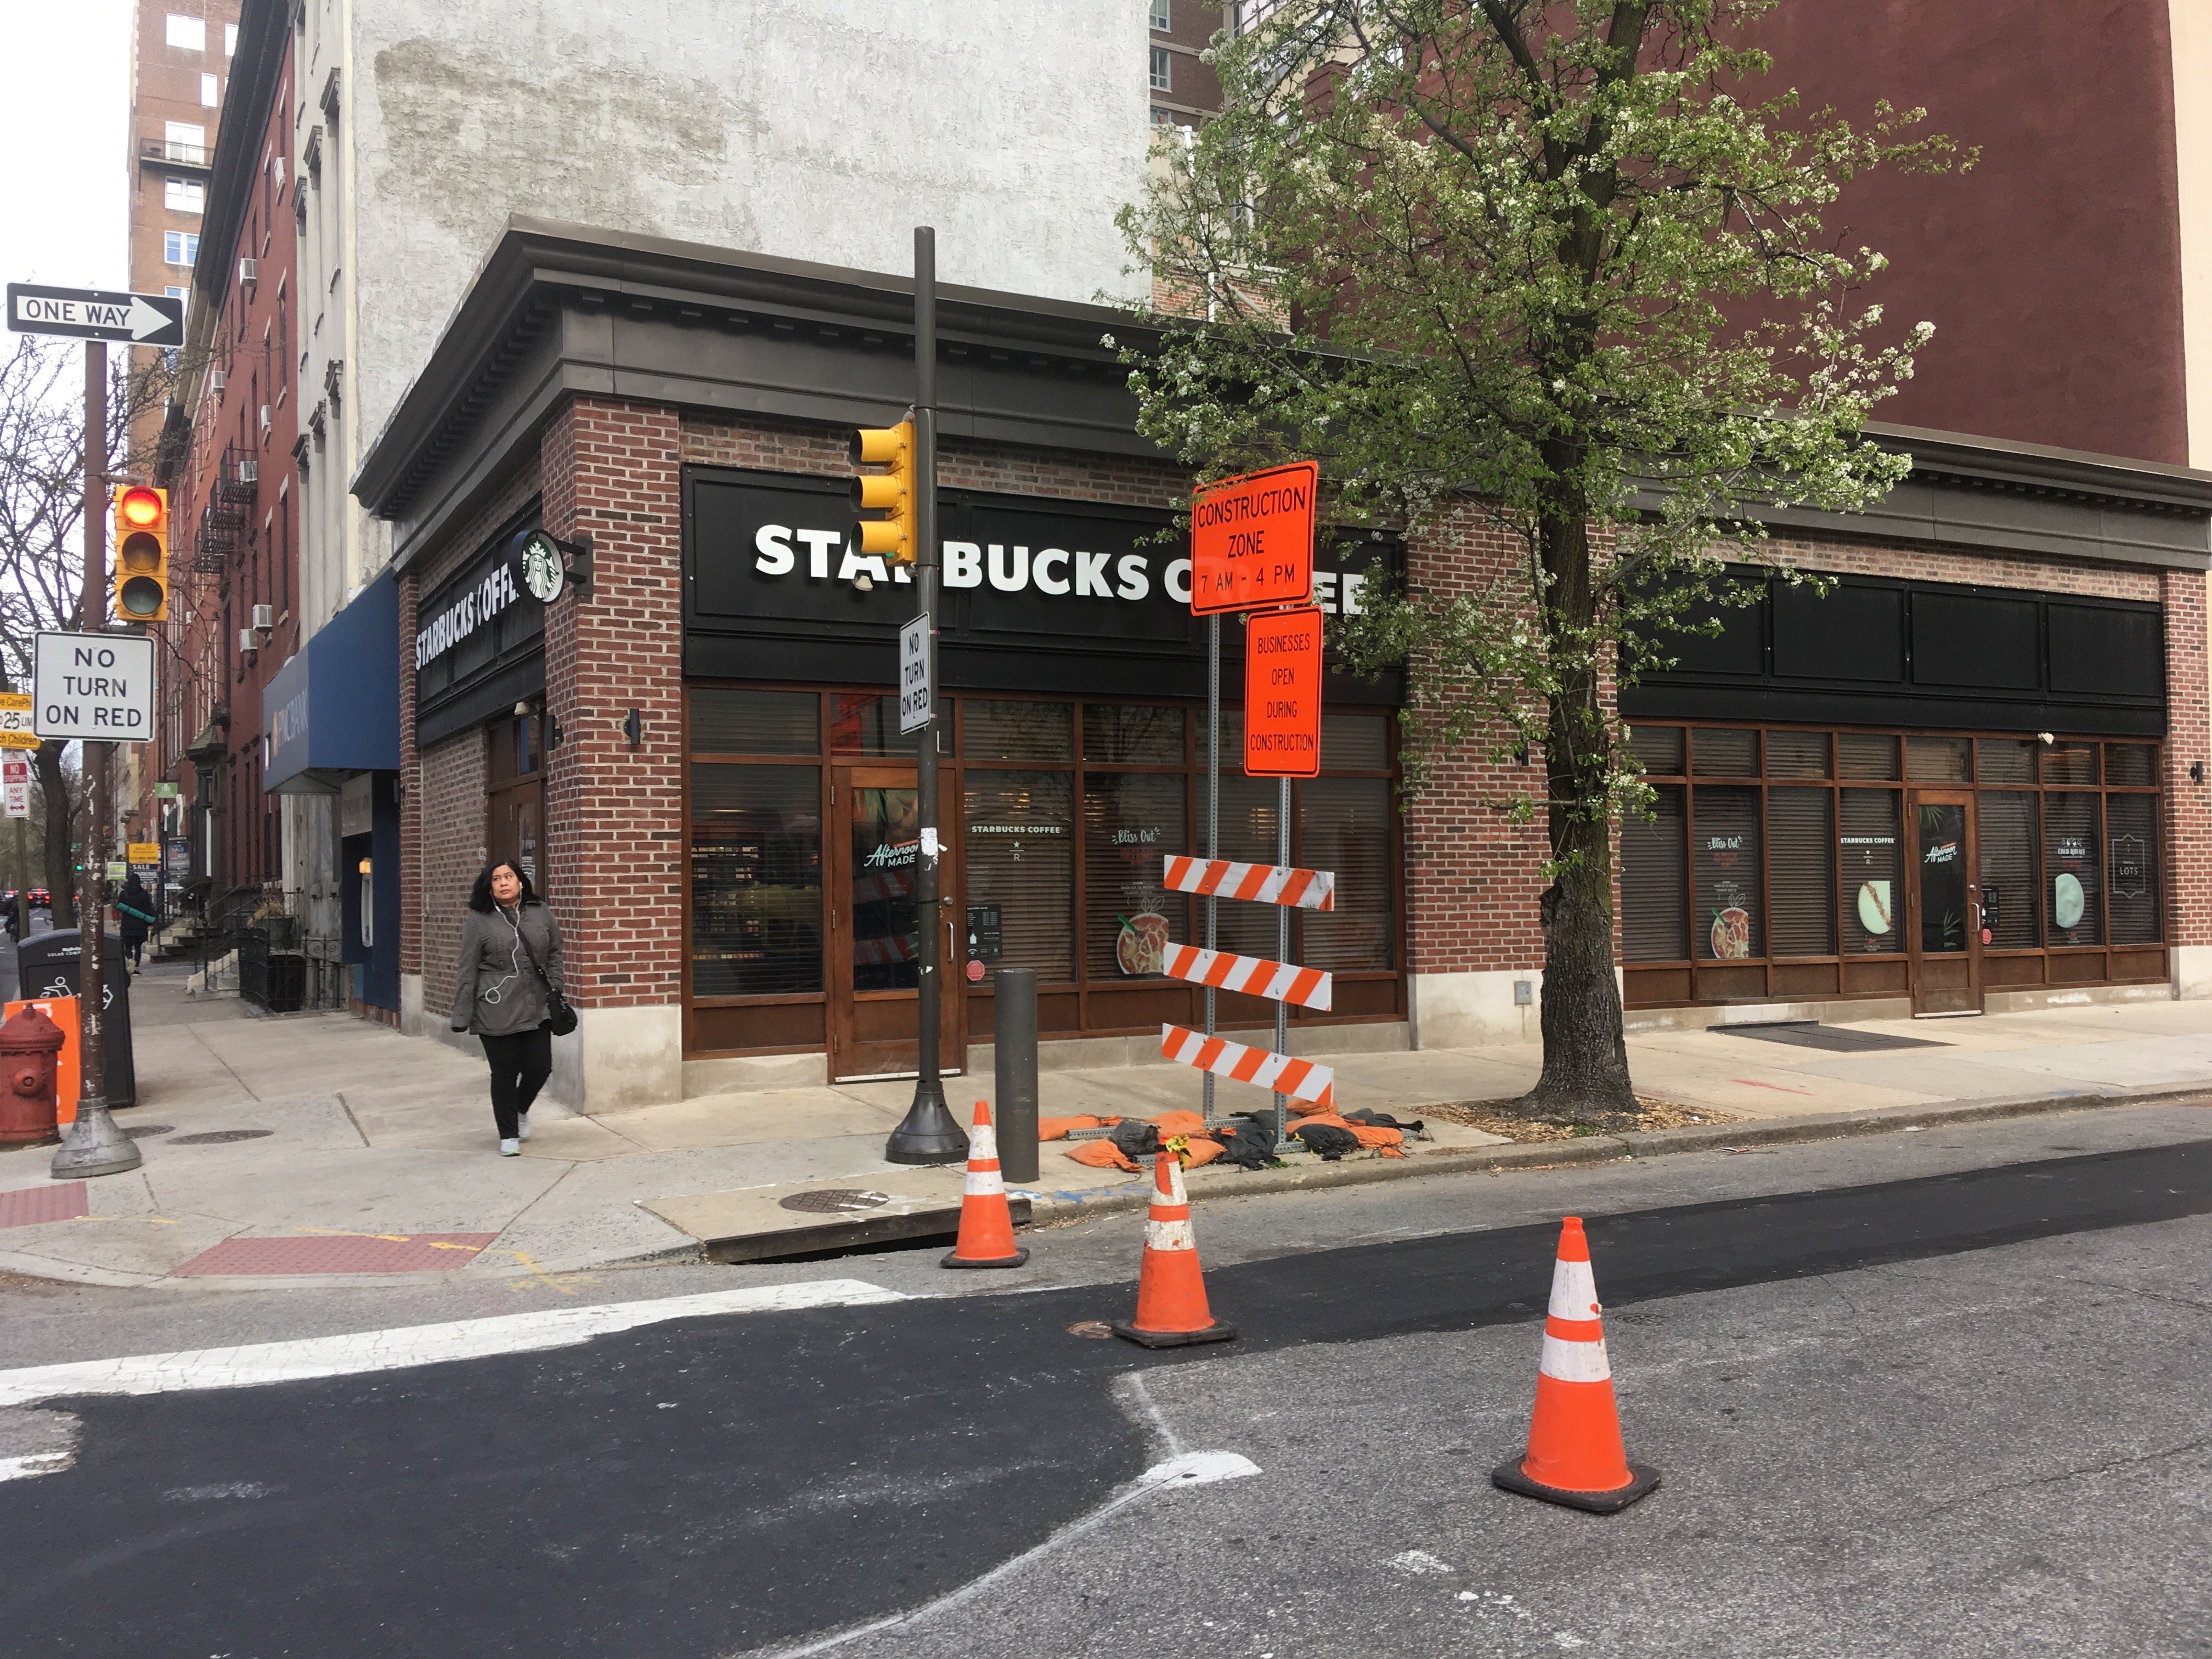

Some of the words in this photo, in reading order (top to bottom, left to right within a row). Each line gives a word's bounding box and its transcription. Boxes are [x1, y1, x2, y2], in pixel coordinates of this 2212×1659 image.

[26, 300, 76, 323] ONE
[85, 304, 132, 326] WAY
[1198, 486, 1306, 528] CONSTRUCTION
[1228, 530, 1265, 558] ZONE
[754, 524, 1149, 601] STABUCKS
[1201, 575, 1207, 593] 7
[1215, 571, 1233, 592] AM
[1256, 567, 1265, 586] 4
[1274, 563, 1295, 584] PM
[415, 591, 474, 670] STARBUCKS
[477, 562, 520, 627] COFFE
[909, 631, 919, 656] NO
[1257, 633, 1311, 654] BUSINESSES
[75, 647, 116, 668] NO
[905, 658, 925, 687] TURN
[1271, 667, 1295, 686] OPEN
[63, 676, 127, 698] TURN
[7, 697, 32, 708] CarePhi
[901, 693, 912, 717] ON
[913, 687, 928, 712] RED
[1267, 700, 1298, 719] DURING
[3, 711, 20, 730] 25
[21, 716, 33, 727] LIM
[46, 704, 79, 725] ON
[94, 706, 142, 727] RED
[8, 733, 37, 746] Children
[1250, 733, 1314, 752] CONSTRUCTION
[4, 775, 27, 783] STOPPING
[10, 764, 20, 775] NO
[1118, 830, 1138, 844] Bliss
[1140, 829, 1156, 843] Out
[1711, 837, 1726, 849] Bliss
[887, 854, 916, 867] MADE
[1014, 853, 1020, 861] R
[1937, 854, 1953, 864] MADE
[2119, 867, 2138, 875] LOTS
